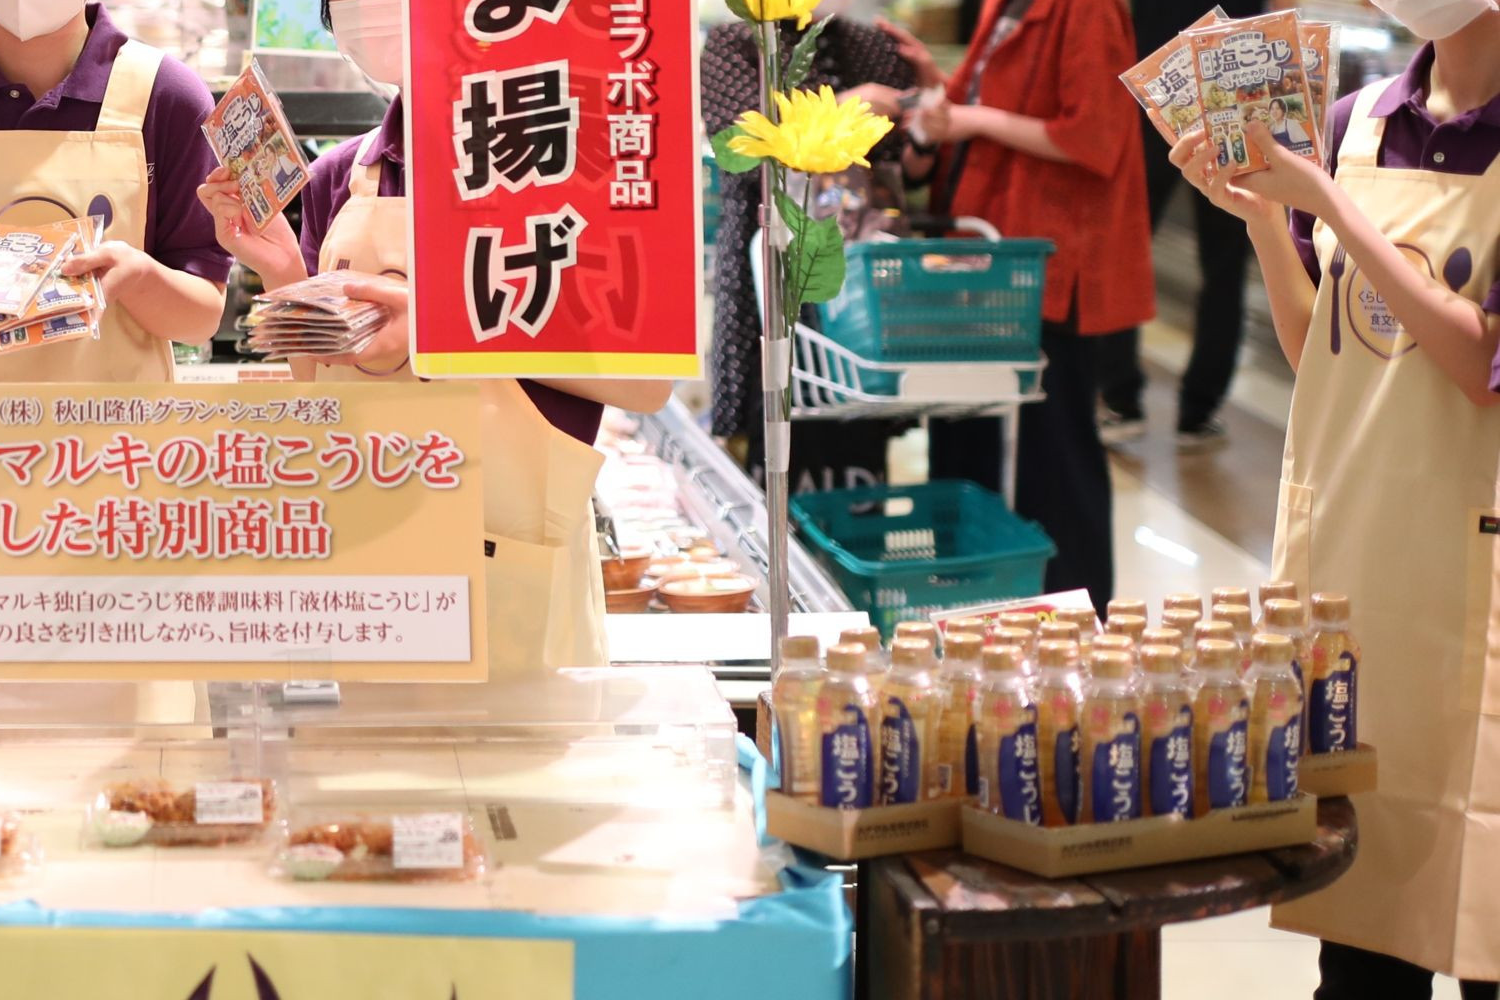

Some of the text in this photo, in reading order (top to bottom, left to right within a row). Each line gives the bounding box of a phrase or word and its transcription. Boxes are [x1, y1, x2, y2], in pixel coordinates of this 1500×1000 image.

[1213, 40, 1291, 73] 塩こうじ
[53, 398, 340, 424] 秋山隆作グラン・シェフ考案
